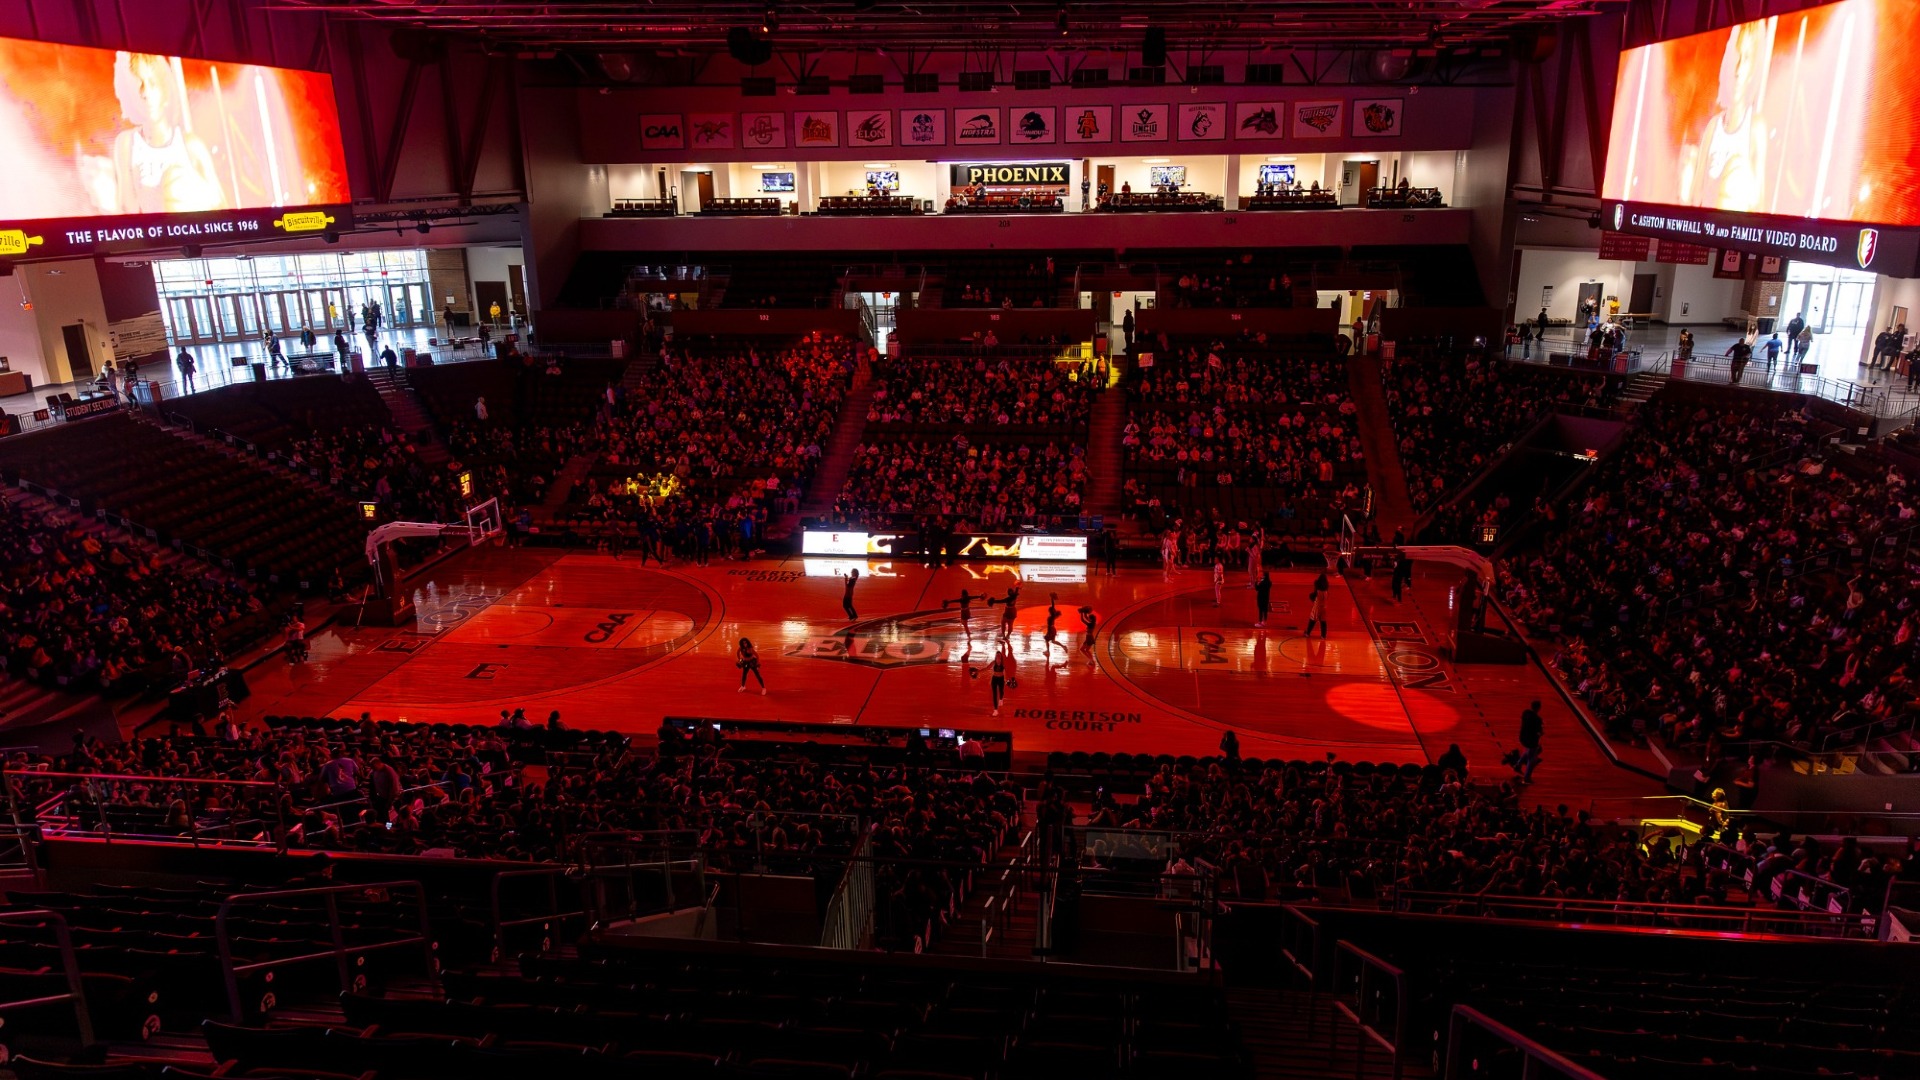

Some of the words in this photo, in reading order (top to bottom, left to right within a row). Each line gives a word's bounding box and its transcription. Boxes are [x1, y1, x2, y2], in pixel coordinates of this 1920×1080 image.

[645, 125, 680, 138] CAA
[857, 129, 886, 139] ELON
[961, 128, 995, 137] HOFSTRA
[970, 166, 1065, 183] PHOENIX
[286, 214, 324, 228] Biscuitville
[999, 220, 1011, 228] 203
[66, 230, 92, 245] THE
[97, 227, 144, 242] FLAVOR
[148, 226, 163, 238] OF
[167, 222, 201, 236] LOCAL
[204, 222, 234, 234] SINCE
[237, 220, 259, 231] 1966
[1631, 213, 1638, 226] C.
[1638, 215, 1665, 230] ASHTON
[1666, 218, 1702, 234] NEWHALL
[1703, 222, 1715, 236] '98
[1715, 227, 1730, 238] AND
[1730, 226, 1764, 243] FAMILY
[1765, 229, 1797, 247] VIDEO
[1799, 233, 1838, 253] BOARD
[66, 404, 93, 418] STUDENT
[93, 398, 116, 412] SECTION
[1483, 534, 1494, 542] 30
[727, 569, 807, 577] ROBERTSO
[746, 575, 799, 583] COURT
[583, 612, 635, 643] CAA
[1195, 629, 1229, 664] CAA
[1369, 619, 1457, 694] ELON
[463, 662, 511, 680] E
[1013, 708, 1142, 723] ROBERTSON
[1045, 720, 1117, 732] COURT
